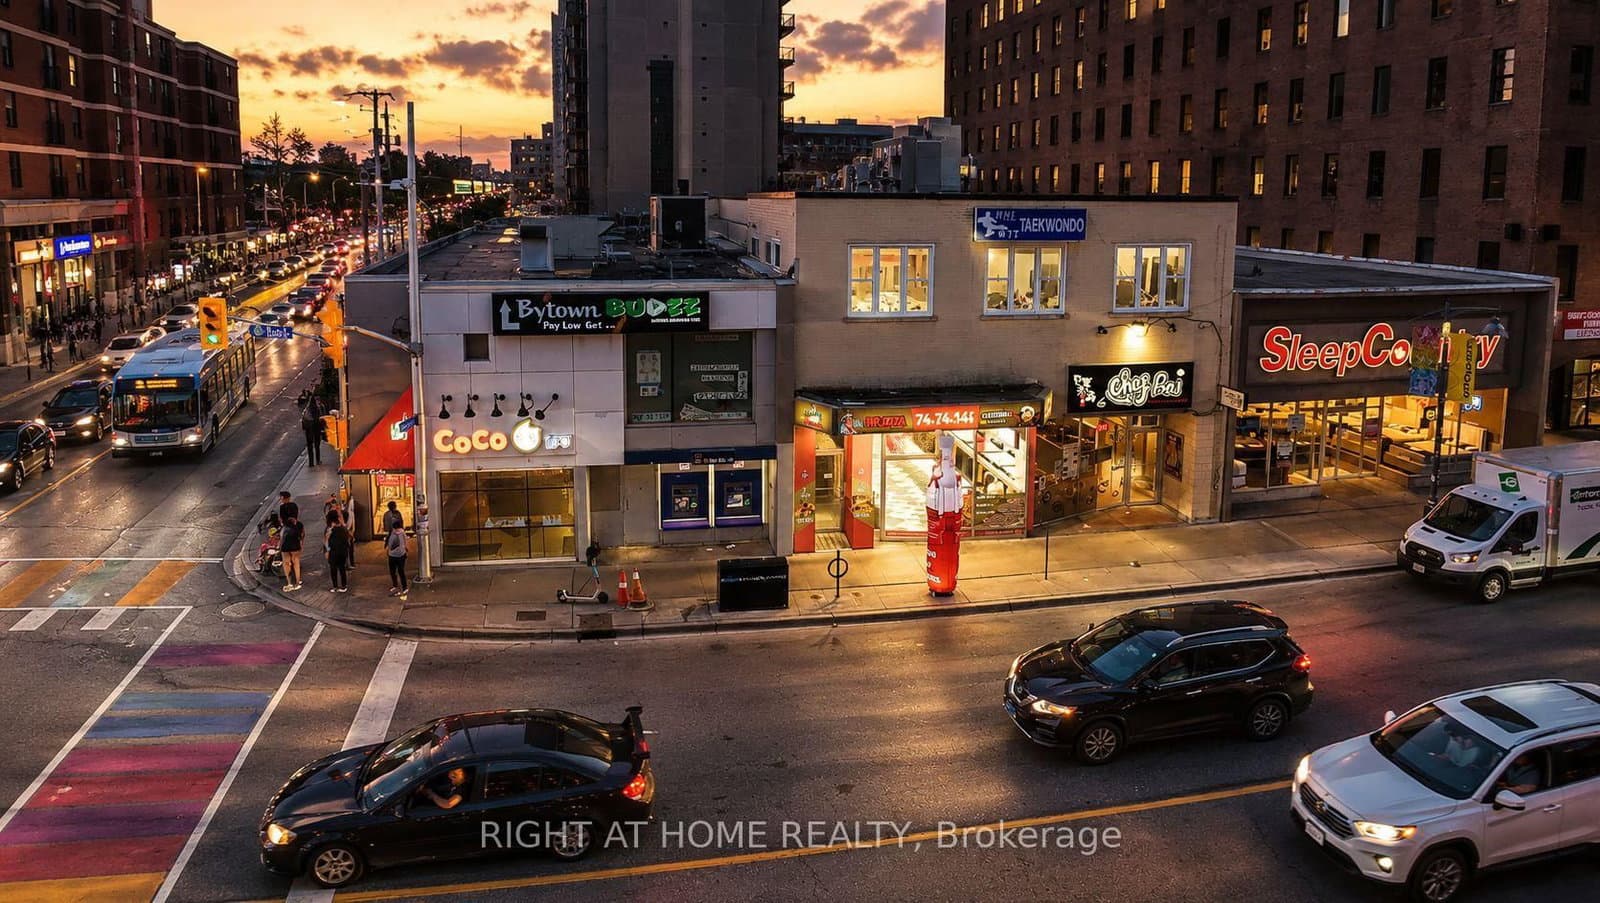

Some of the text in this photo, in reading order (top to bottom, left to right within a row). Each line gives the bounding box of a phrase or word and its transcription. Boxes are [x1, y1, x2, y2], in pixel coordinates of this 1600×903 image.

[1019, 217, 1085, 233] TAEKWONDO
[515, 298, 603, 324] Bytown
[543, 321, 560, 332] Pay
[562, 321, 581, 330] Low
[585, 321, 603, 330] Get
[433, 429, 508, 454] CoCo
